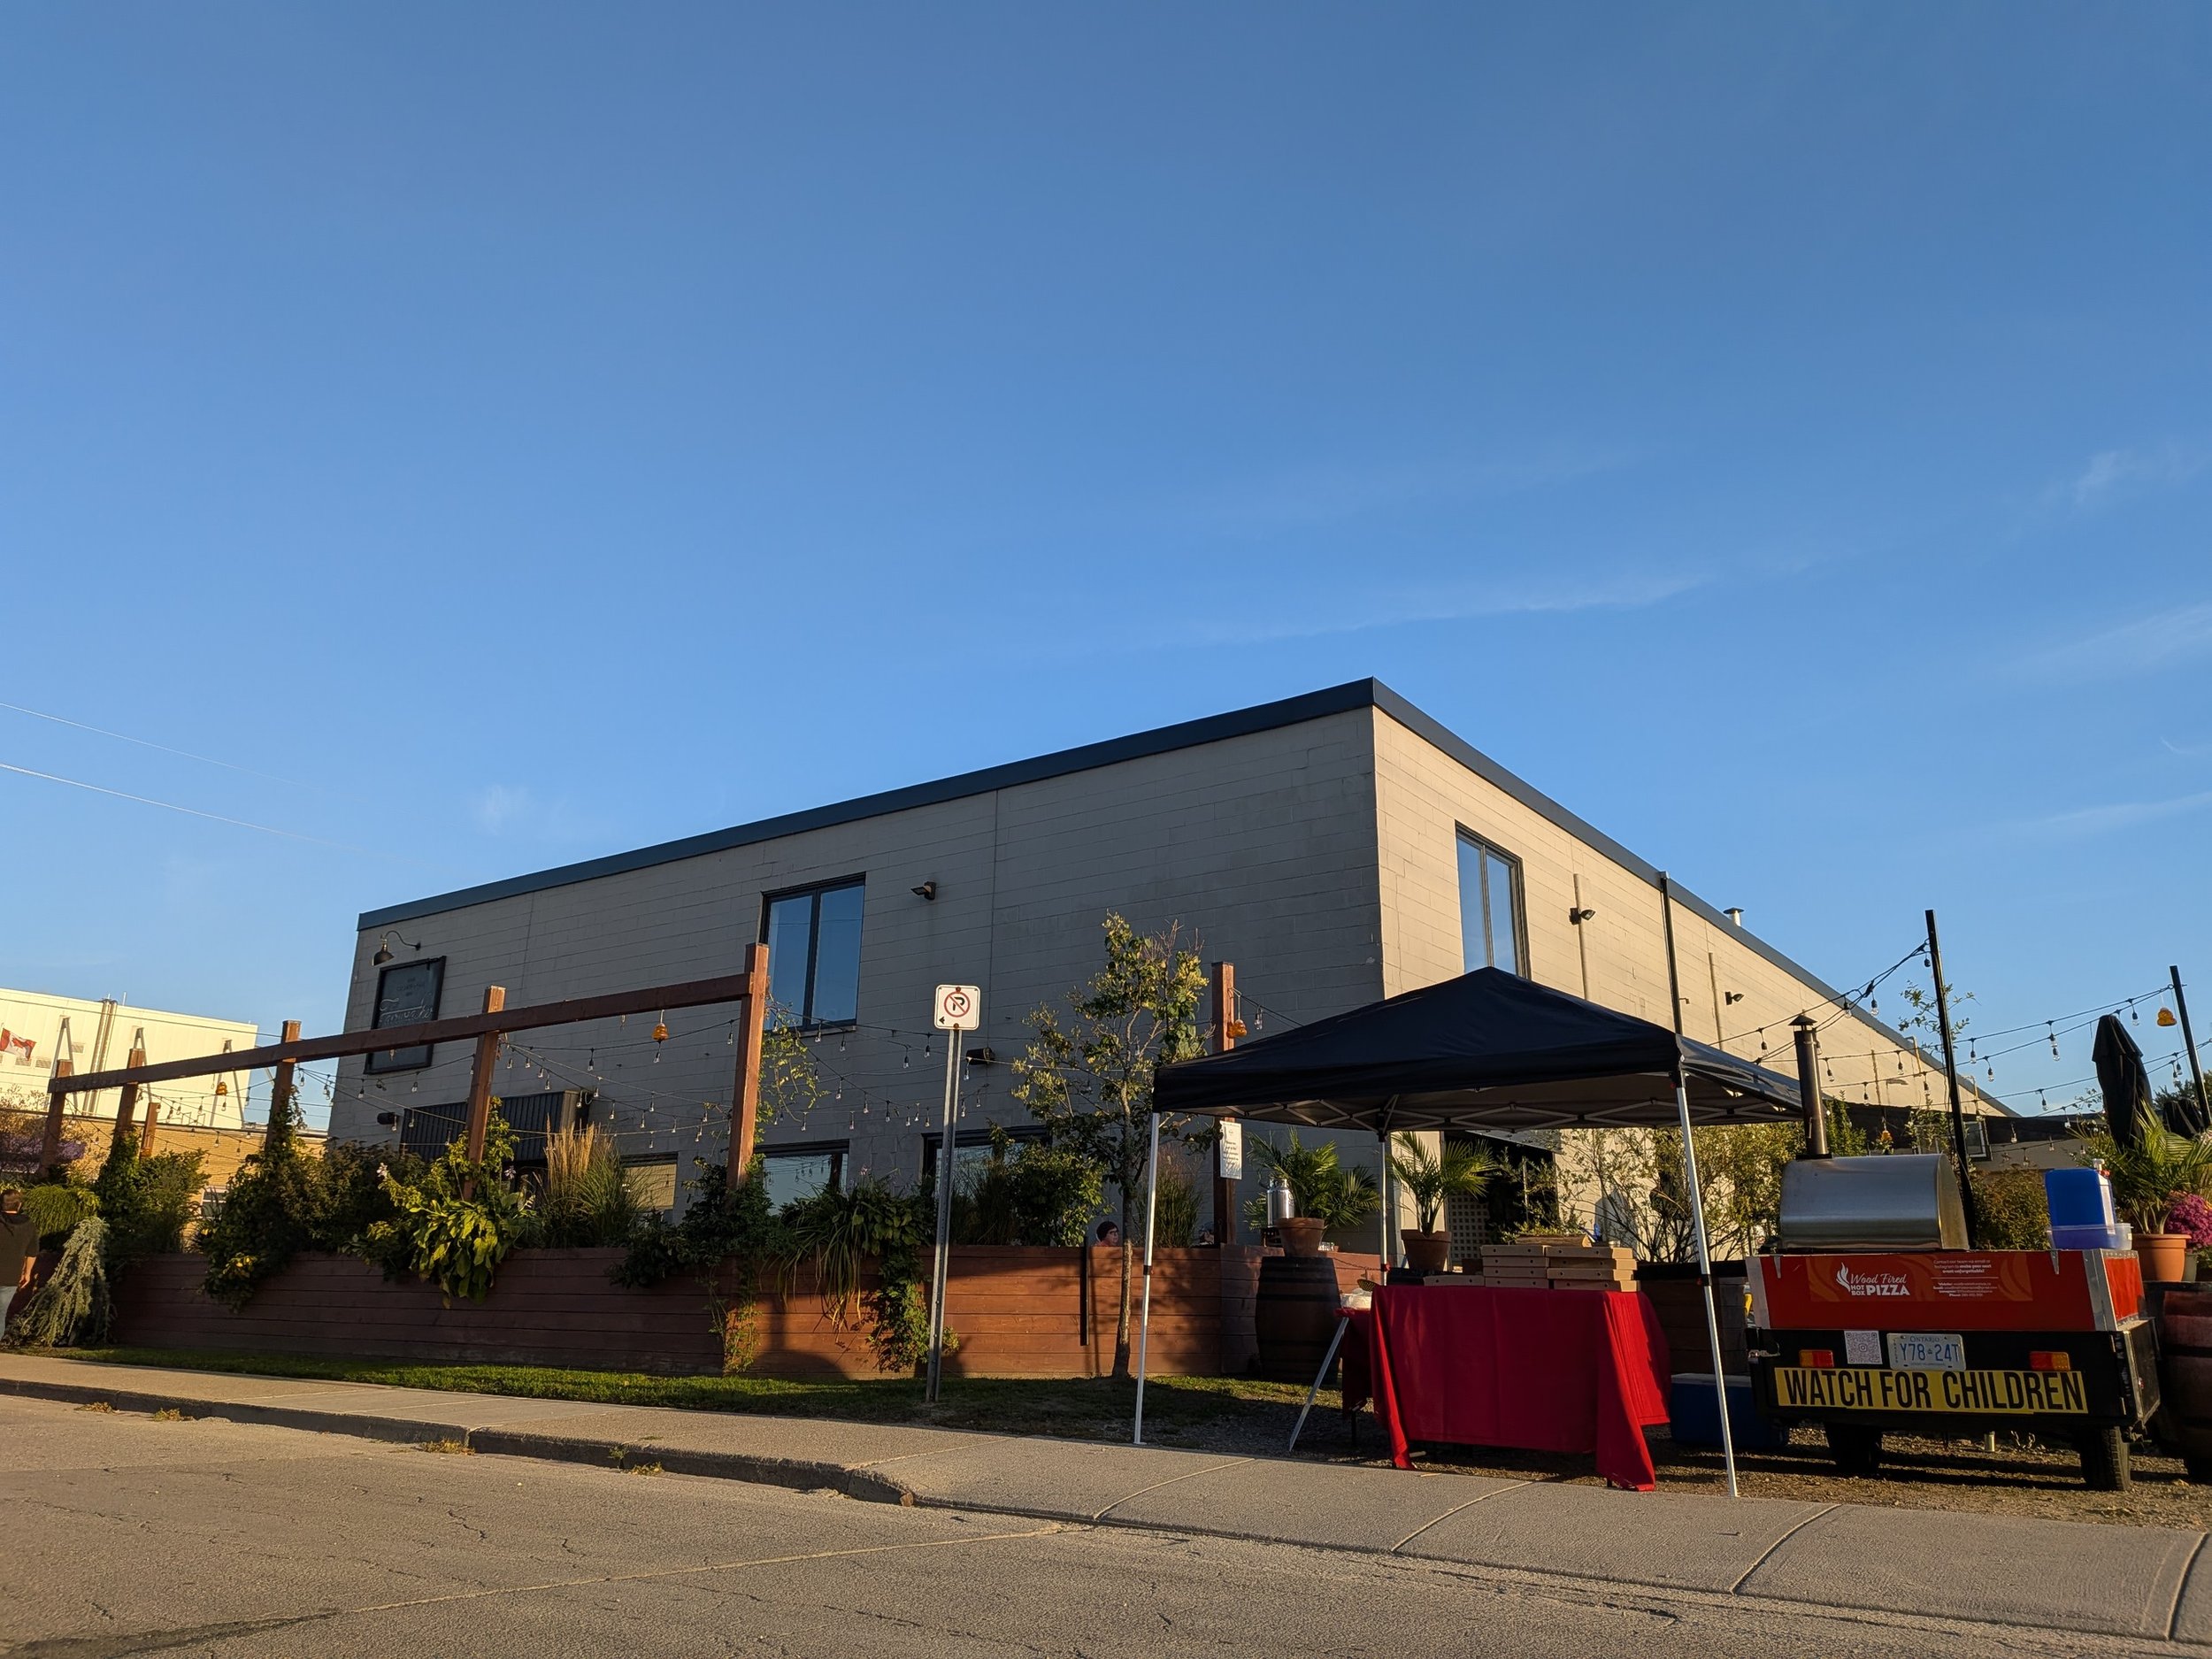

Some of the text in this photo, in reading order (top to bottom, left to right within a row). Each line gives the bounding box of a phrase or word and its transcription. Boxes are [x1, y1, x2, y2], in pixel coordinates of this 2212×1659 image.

[1850, 1273, 1907, 1284] Wood Fired
[1866, 1284, 1910, 1296] PIZZA
[1784, 1370, 2082, 1410] WATCH FOR CHILDREN
